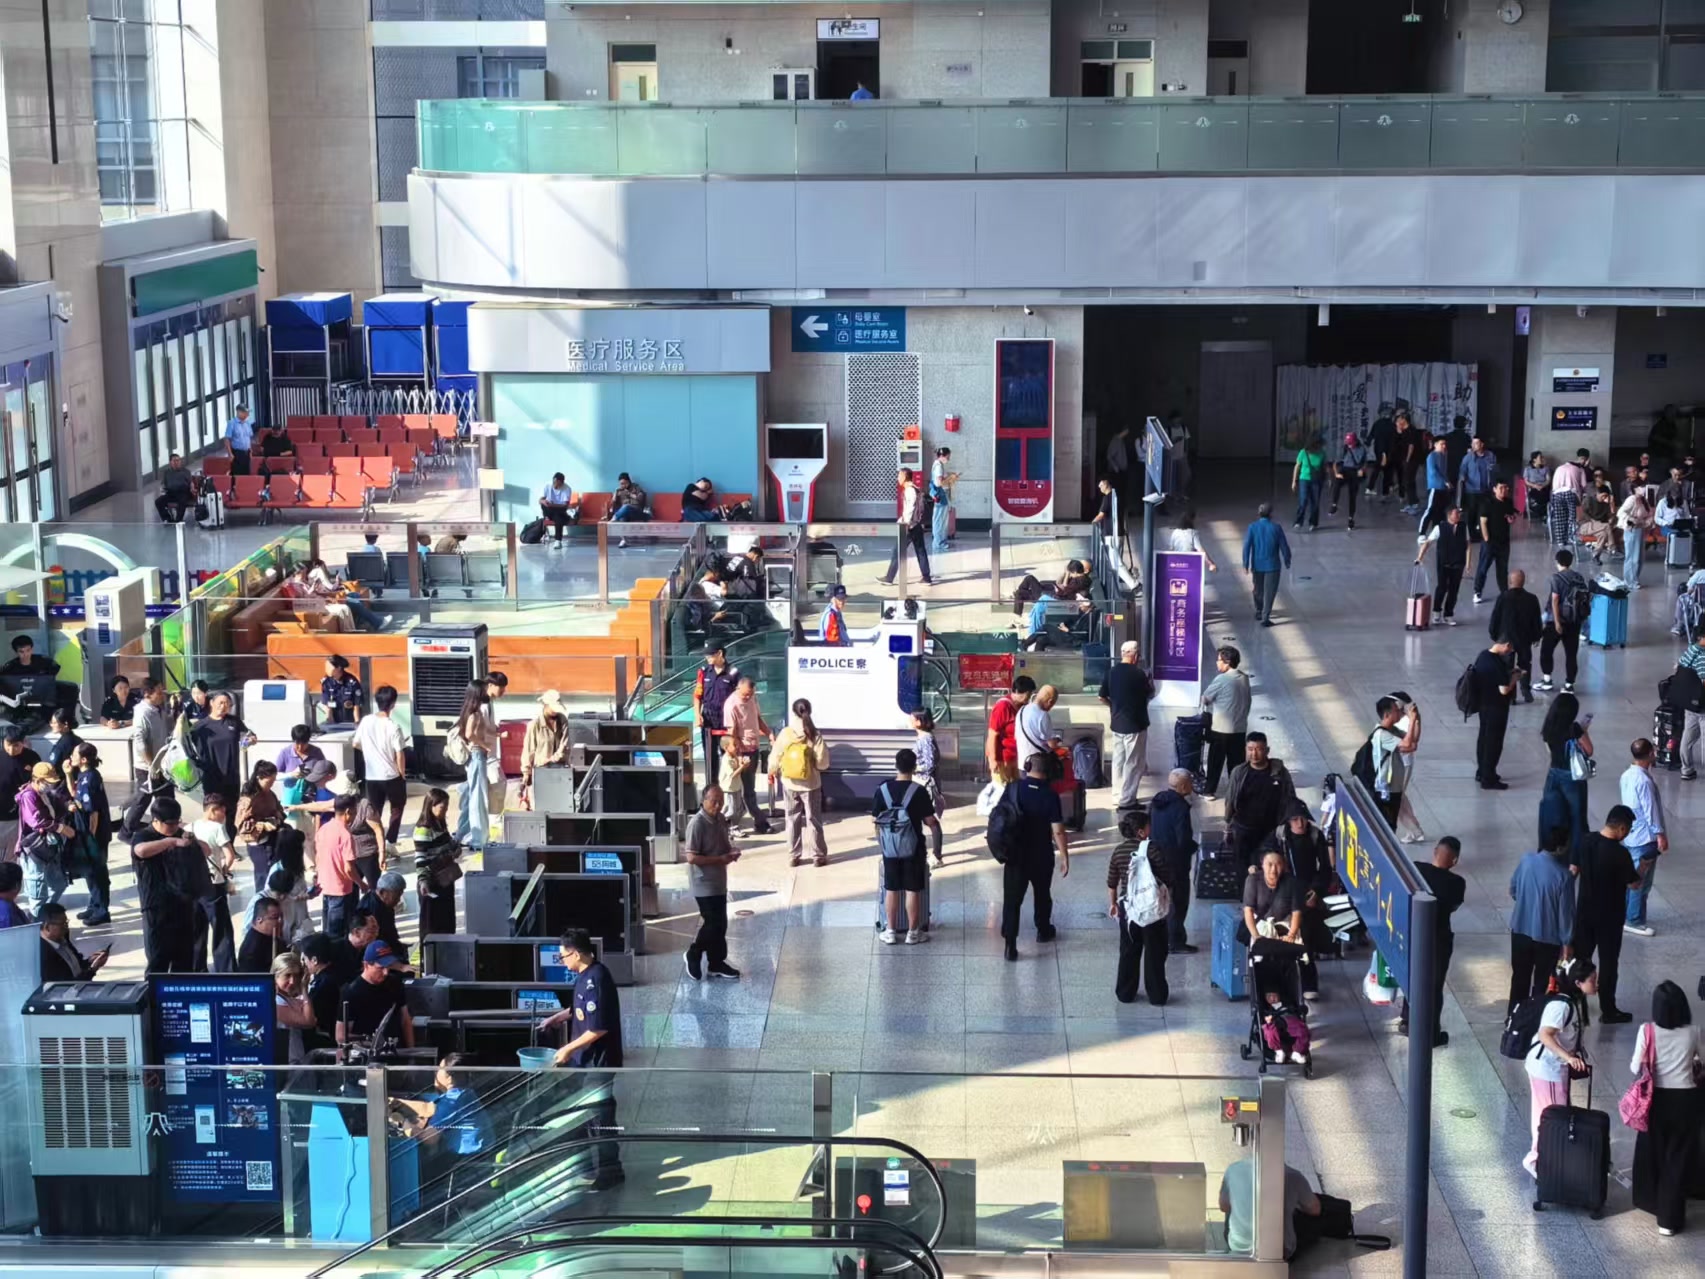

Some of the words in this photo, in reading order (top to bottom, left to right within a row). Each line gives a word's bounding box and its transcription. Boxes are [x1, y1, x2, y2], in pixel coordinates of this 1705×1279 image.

[568, 338, 684, 360] 医疗服务区
[568, 361, 608, 372] Medical
[615, 361, 654, 371] Service
[660, 361, 685, 371] Area
[1175, 598, 1187, 657] 商务座候车区
[810, 658, 854, 668] POLICE
